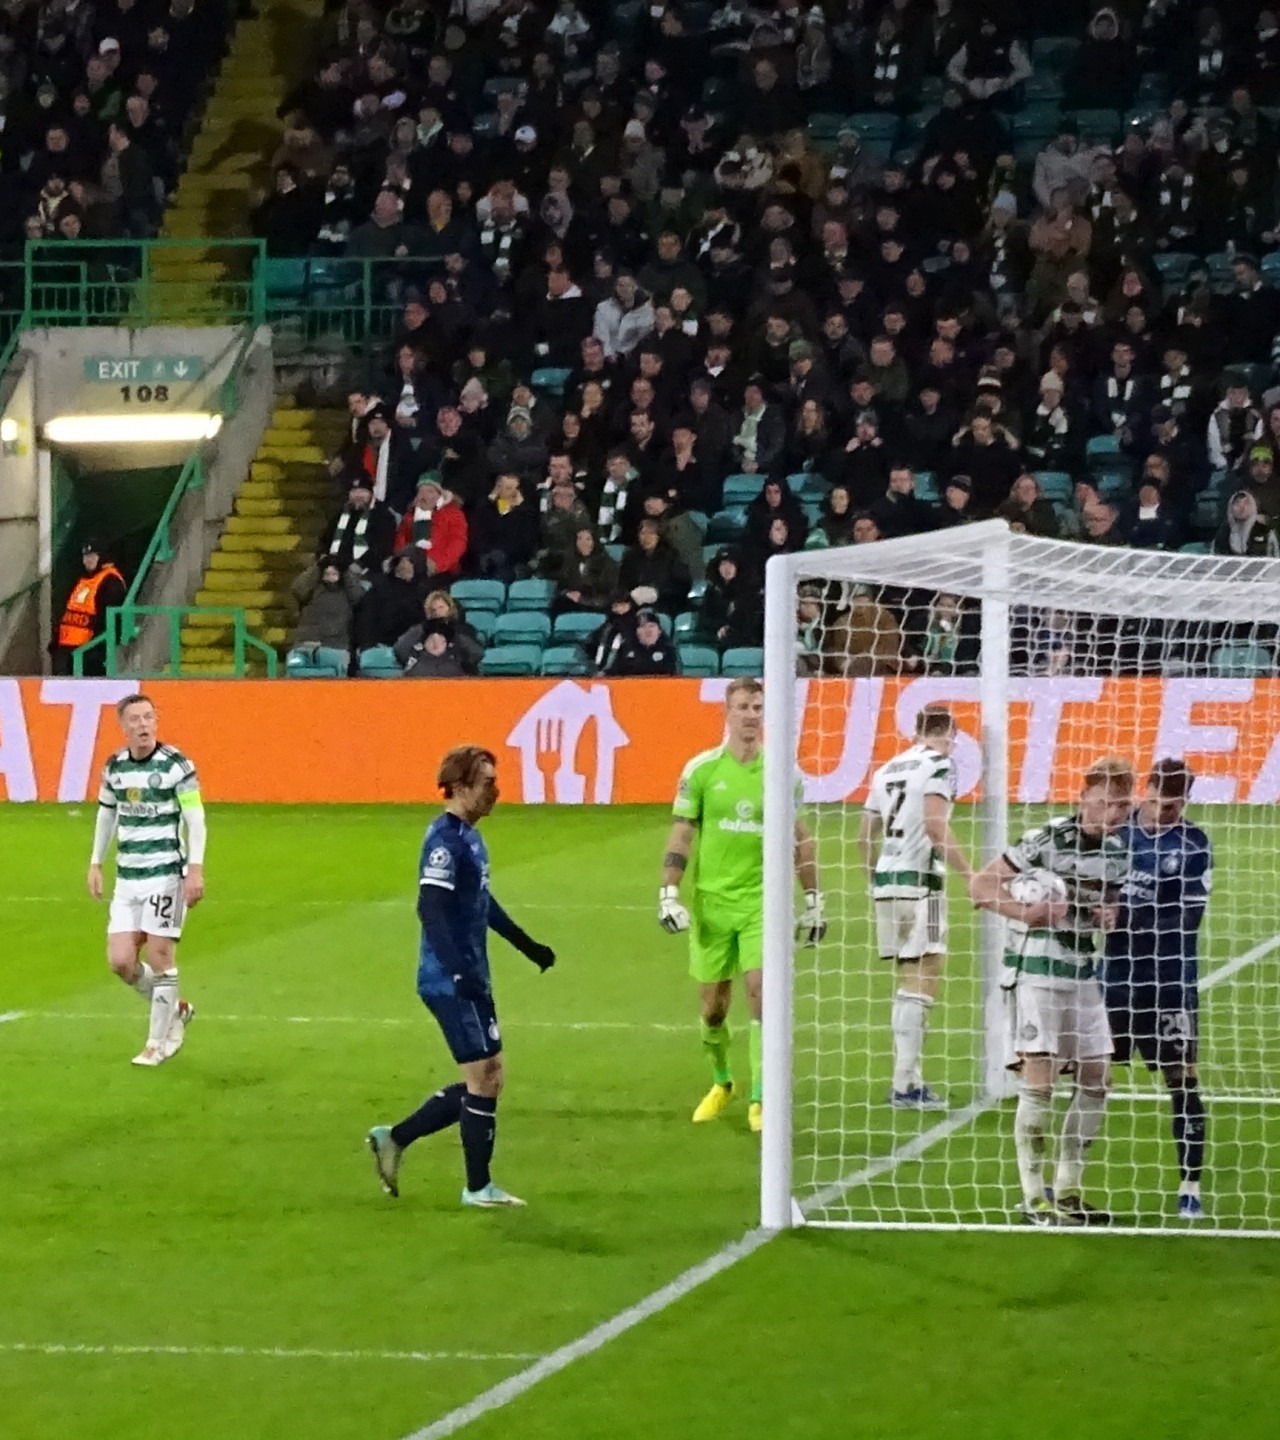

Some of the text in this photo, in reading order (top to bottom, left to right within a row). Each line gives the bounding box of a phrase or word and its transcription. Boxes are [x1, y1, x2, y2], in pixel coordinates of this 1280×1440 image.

[99, 361, 139, 379] EXIT
[121, 384, 168, 402] 108
[149, 894, 174, 919] 42
